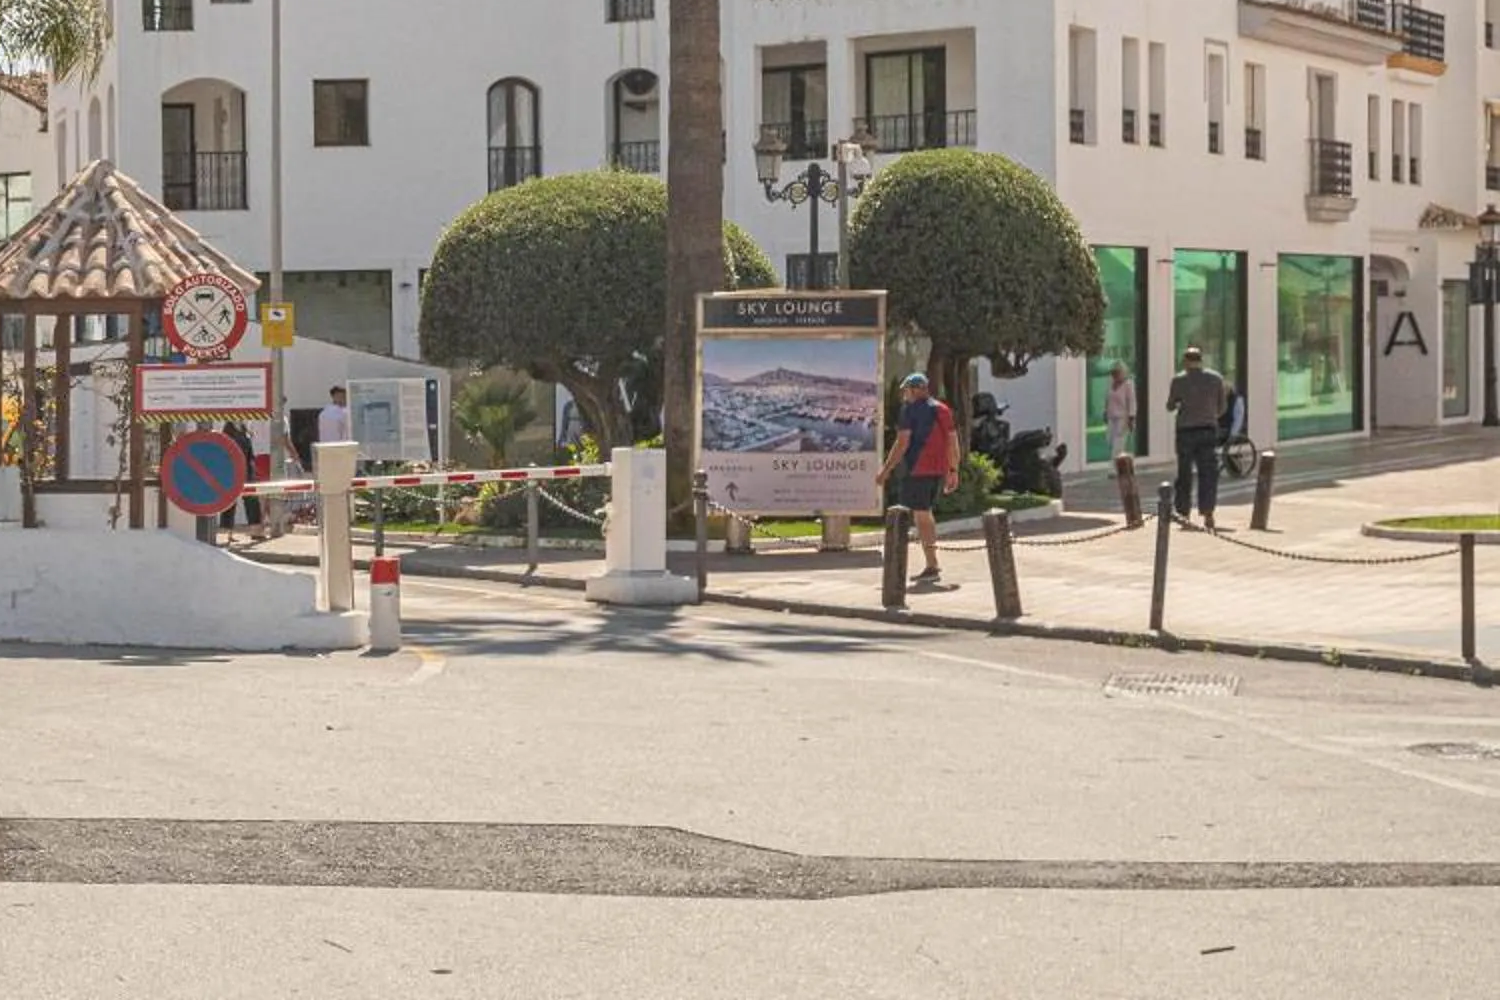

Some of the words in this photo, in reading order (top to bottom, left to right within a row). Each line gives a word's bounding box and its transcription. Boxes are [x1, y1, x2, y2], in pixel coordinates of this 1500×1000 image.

[185, 275, 245, 312] AUTORIZADO
[737, 302, 767, 315] SKY
[775, 301, 844, 315] LOUNGE
[1384, 310, 1428, 356] A
[771, 458, 799, 471] SKY
[806, 458, 867, 471] LOUNGE
